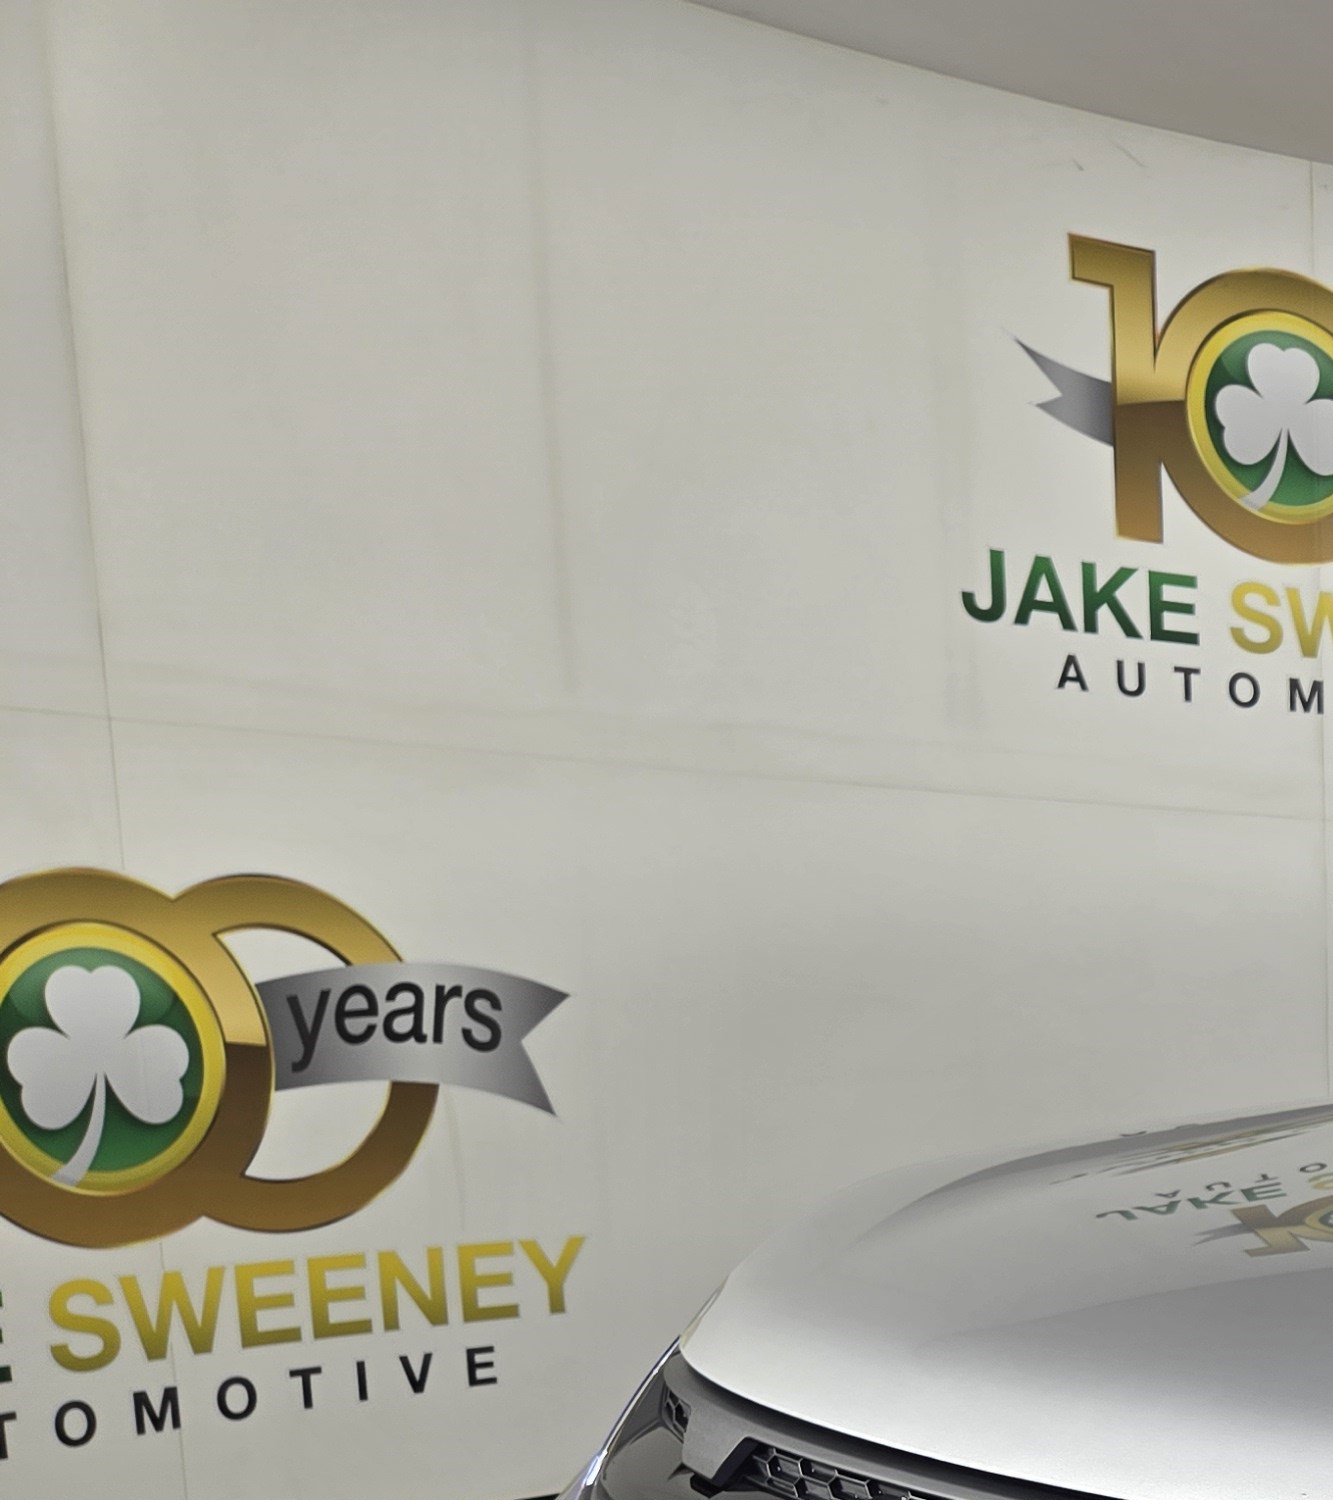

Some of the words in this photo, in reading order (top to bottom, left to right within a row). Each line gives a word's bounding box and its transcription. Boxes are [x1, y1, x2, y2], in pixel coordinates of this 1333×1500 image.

[960, 548, 1200, 646] JAKE
[286, 980, 503, 1073] years
[48, 1235, 586, 1373] SWEENEY
